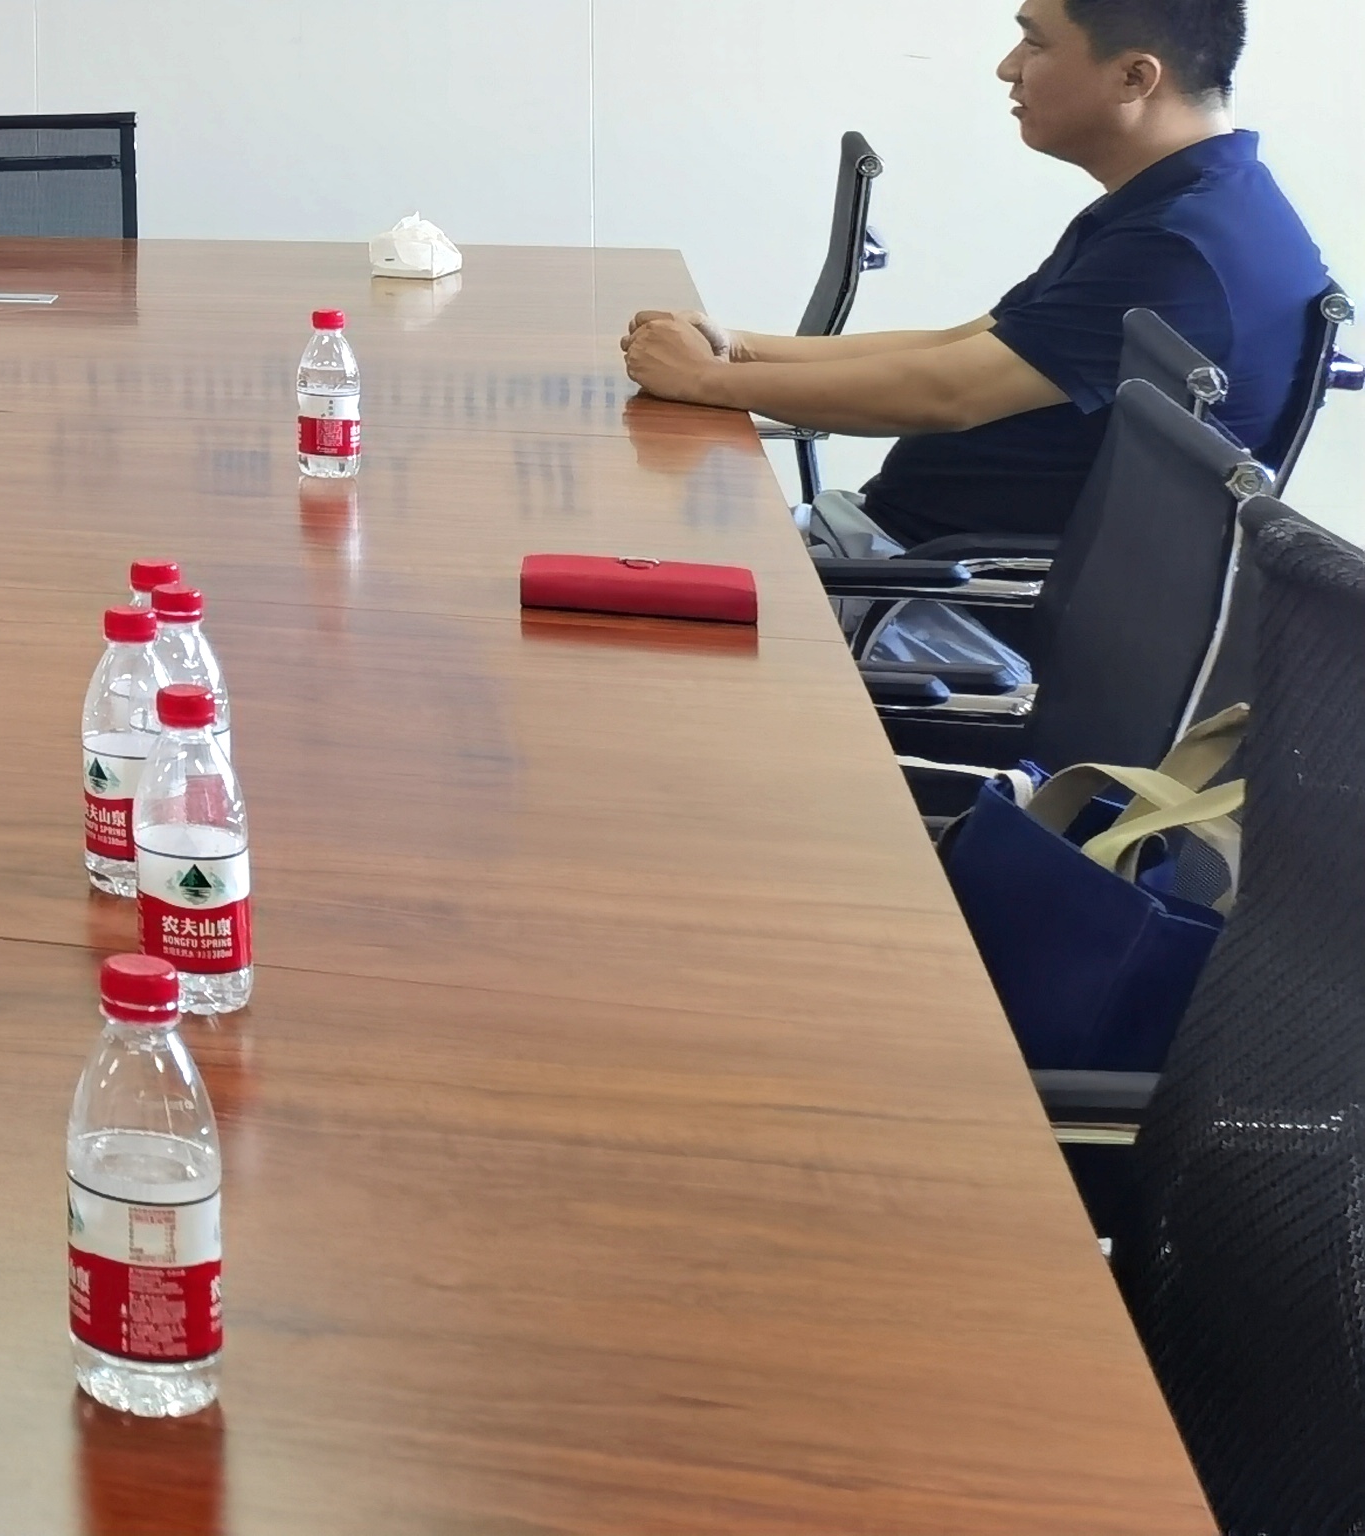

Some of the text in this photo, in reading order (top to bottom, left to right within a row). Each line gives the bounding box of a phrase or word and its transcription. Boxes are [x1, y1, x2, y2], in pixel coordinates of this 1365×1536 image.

[161, 915, 232, 937] 农夫山泉
[162, 935, 233, 950] NONGFU SPRING
